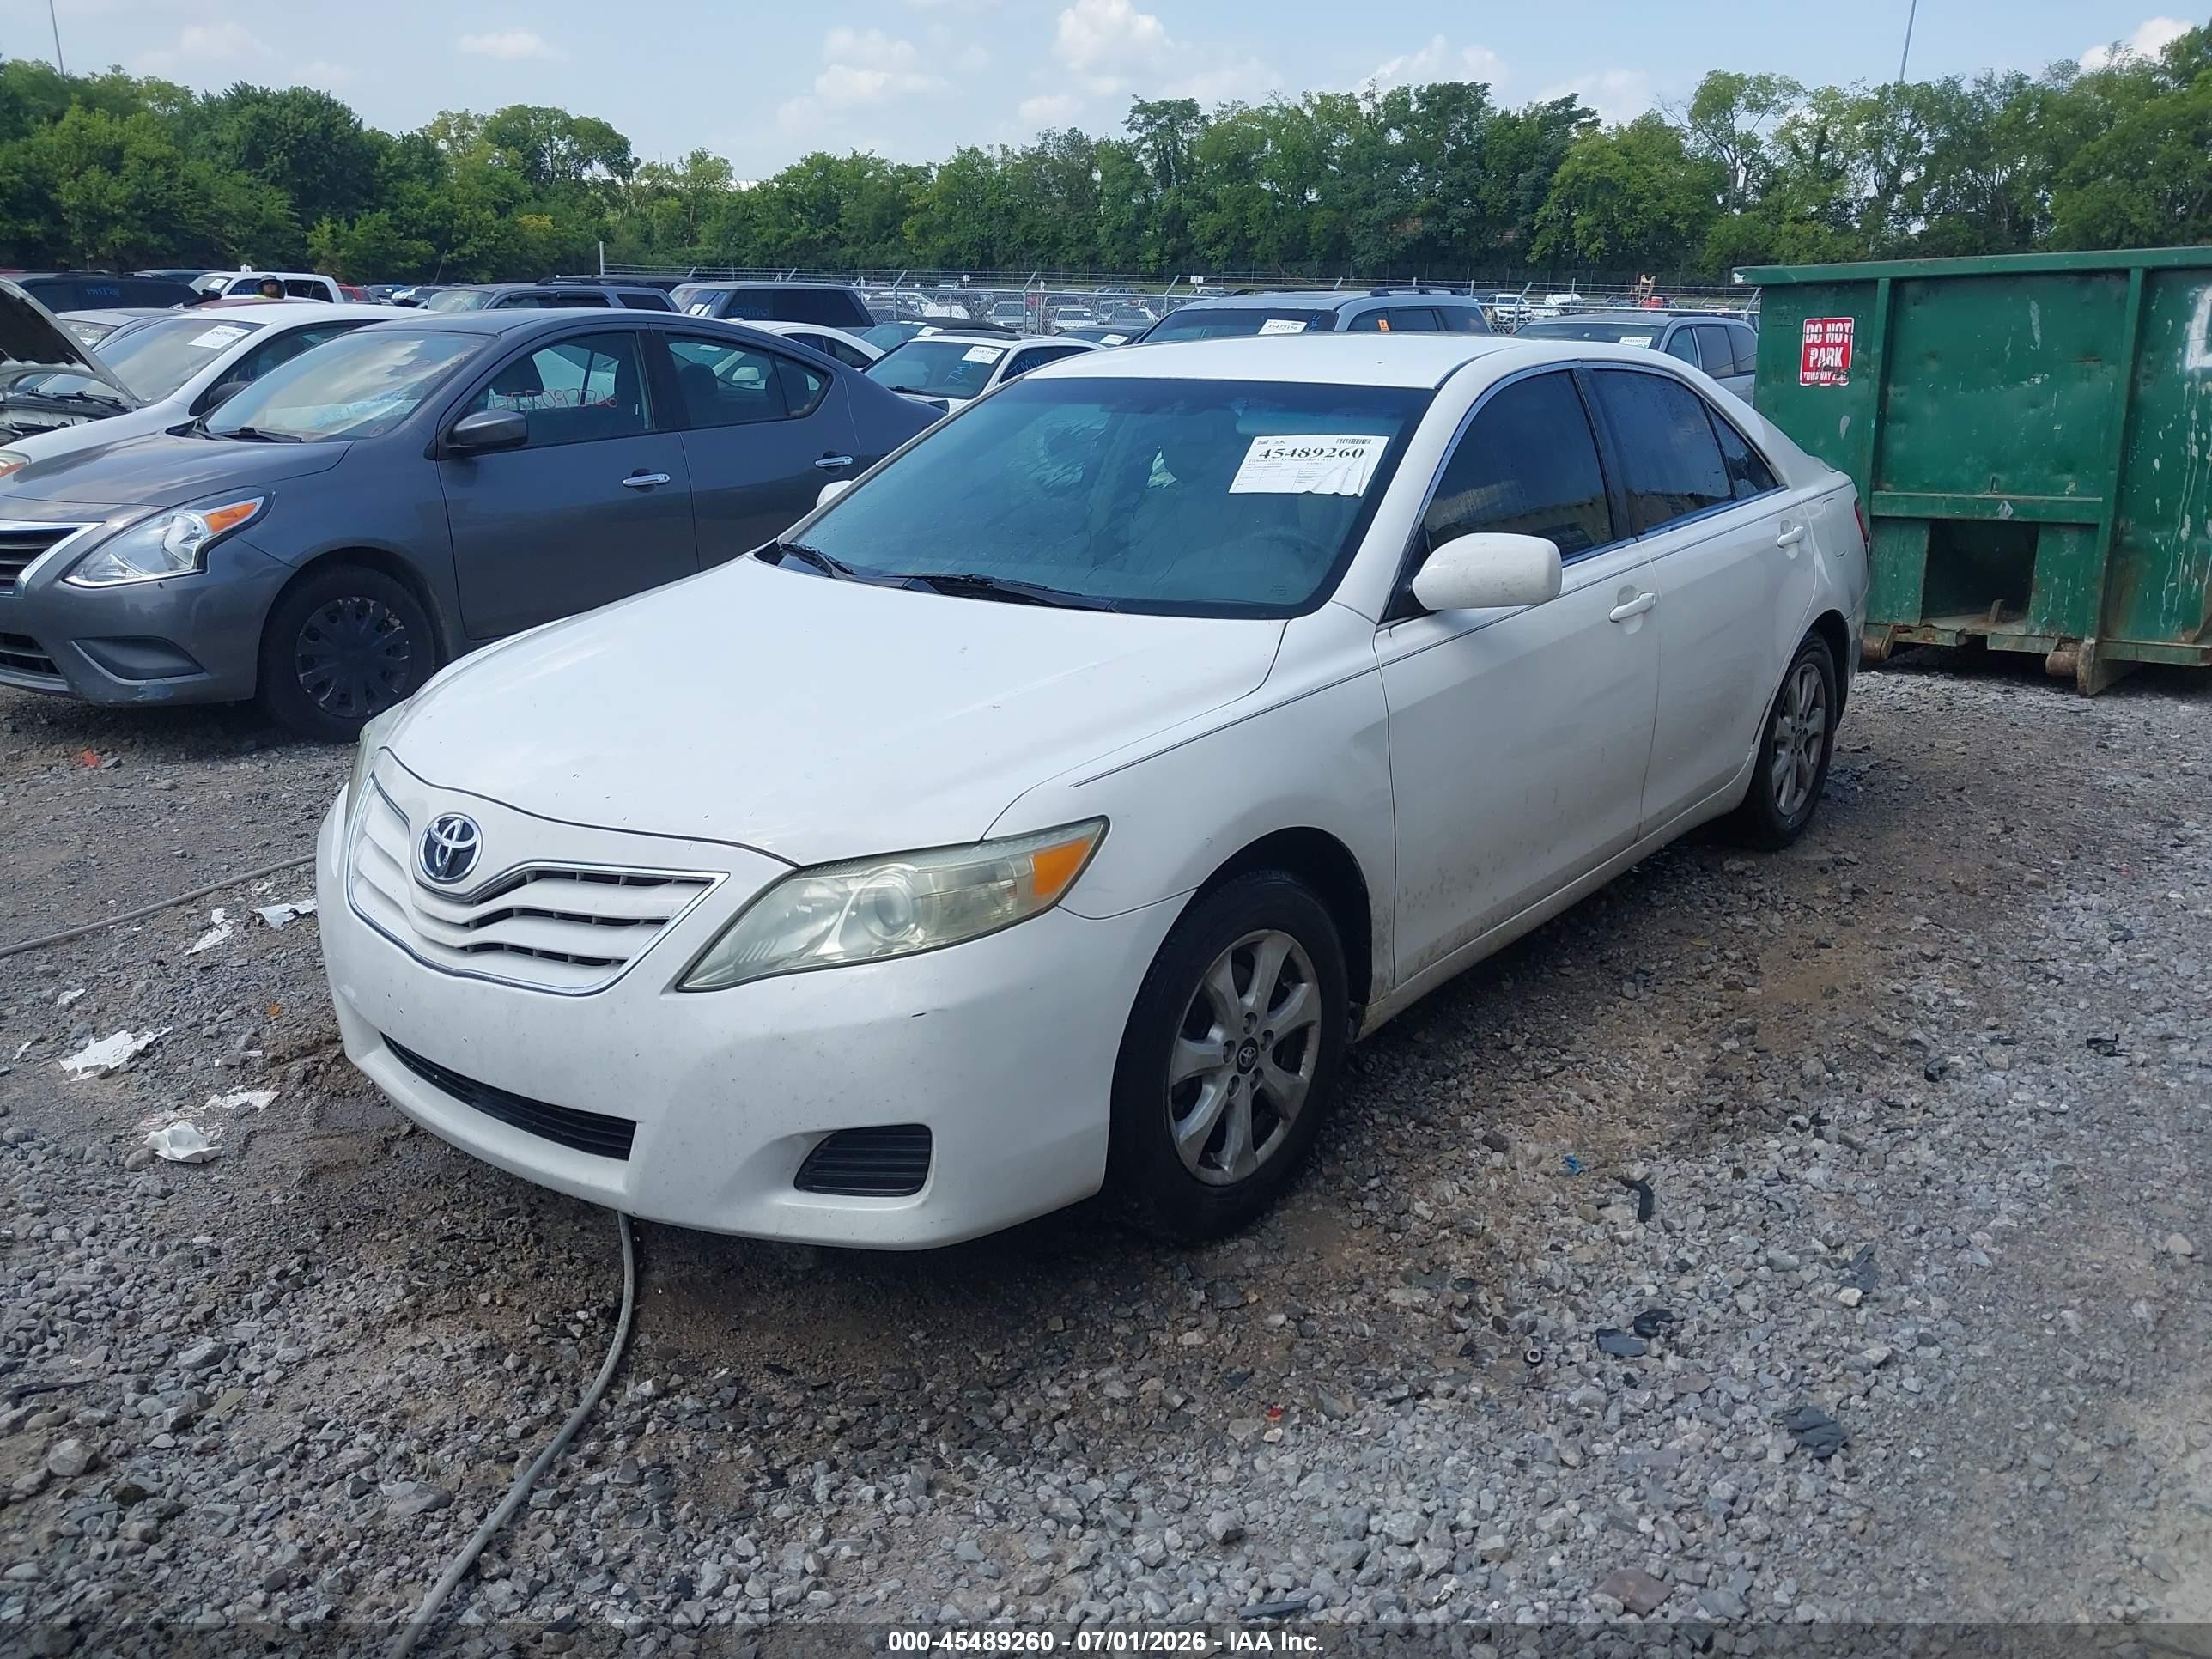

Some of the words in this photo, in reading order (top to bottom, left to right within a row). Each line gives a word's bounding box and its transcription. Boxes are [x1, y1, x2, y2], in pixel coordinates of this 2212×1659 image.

[1805, 324, 1822, 344] DO
[1826, 322, 1851, 344] NOT
[1808, 346, 1844, 368] PARK
[1259, 447, 1364, 459] 45489260
